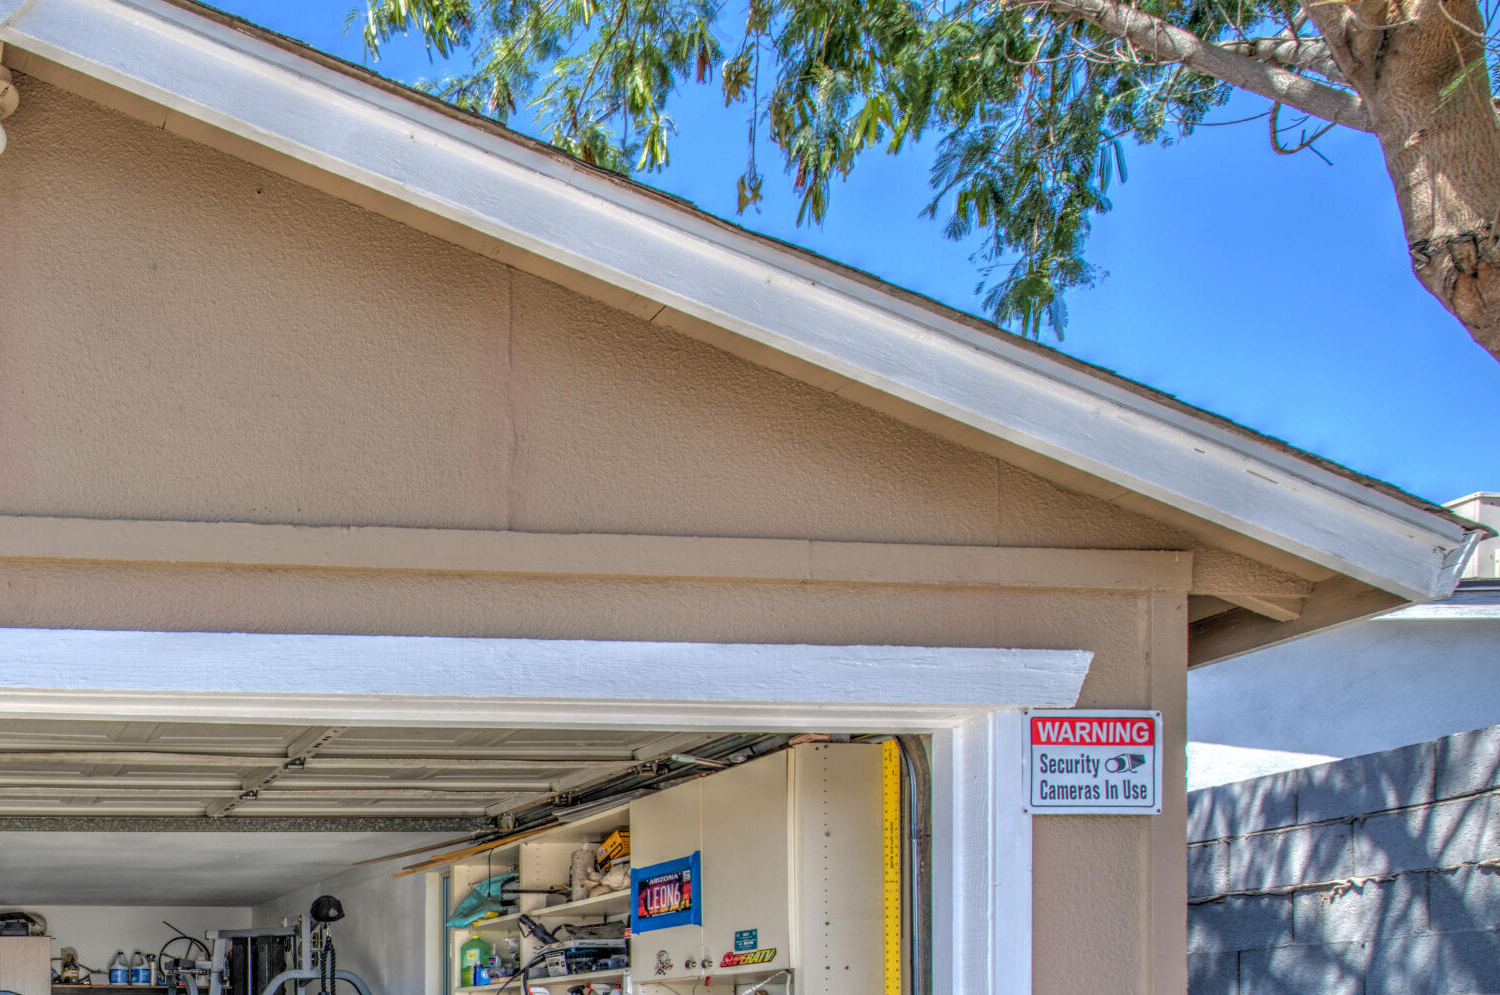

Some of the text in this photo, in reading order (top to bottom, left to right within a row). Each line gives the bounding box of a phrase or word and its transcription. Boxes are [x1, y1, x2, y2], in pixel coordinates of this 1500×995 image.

[1037, 721, 1149, 743] WARNING
[1040, 753, 1100, 778] Security
[1040, 779, 1147, 800] Cameras In Use
[650, 873, 679, 884] ARIZONA
[647, 882, 681, 911] LEON6
